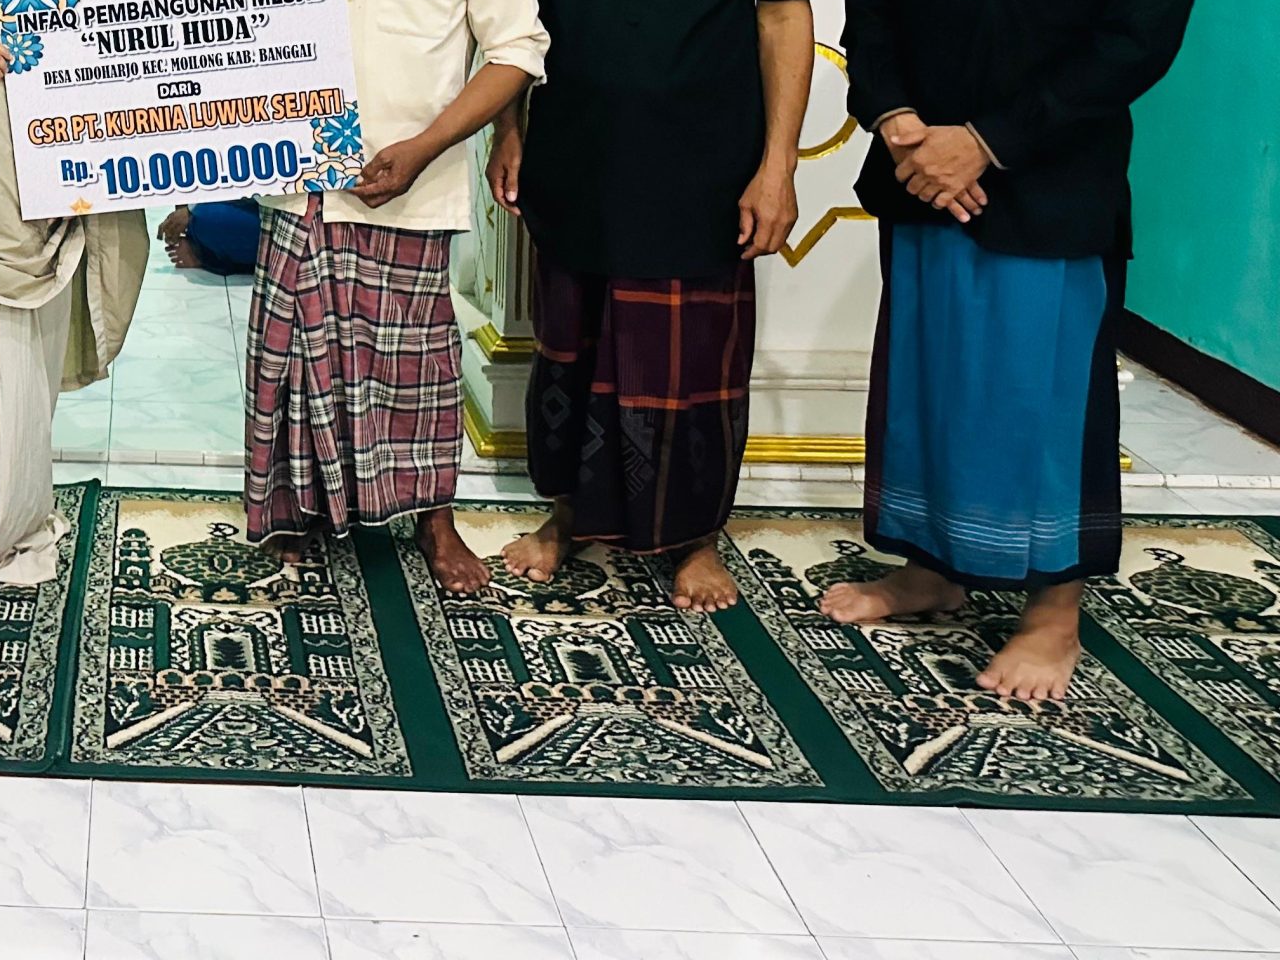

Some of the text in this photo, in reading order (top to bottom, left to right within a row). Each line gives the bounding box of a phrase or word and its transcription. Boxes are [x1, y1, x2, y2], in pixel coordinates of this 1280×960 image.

[17, 9, 76, 33] INFAQ
[43, 70, 71, 85] DESA
[75, 62, 139, 83] SIDOHARJO
[171, 52, 223, 71] MOILONG
[259, 43, 313, 62] BANGGAI
[28, 88, 344, 144] CSR PT. KURNIA LUWUK SEJATI
[61, 140, 312, 194] Rp. 10.000.000-
